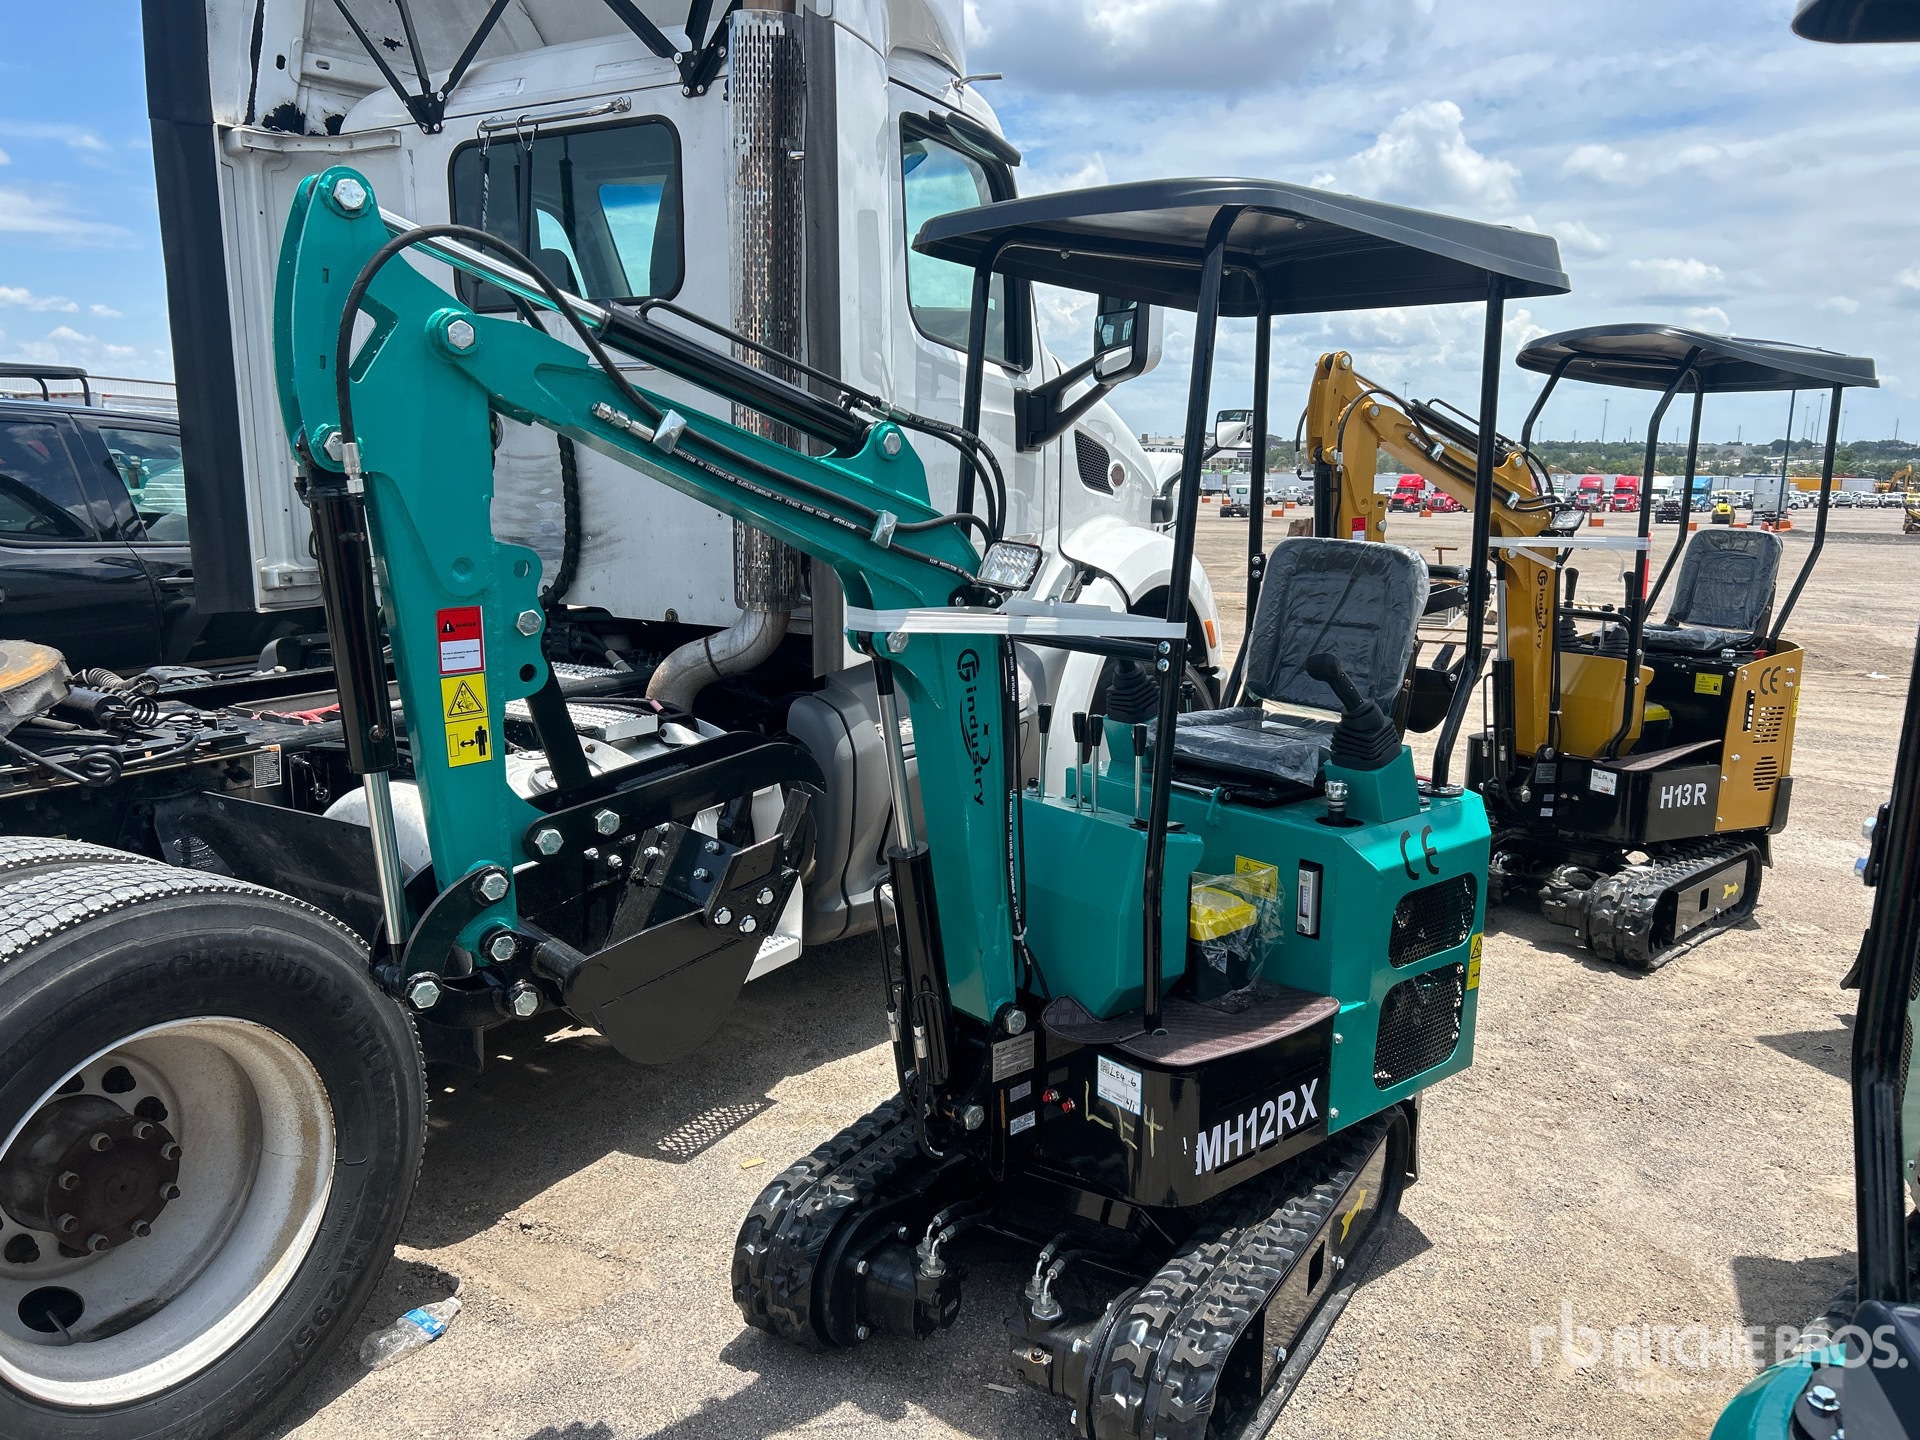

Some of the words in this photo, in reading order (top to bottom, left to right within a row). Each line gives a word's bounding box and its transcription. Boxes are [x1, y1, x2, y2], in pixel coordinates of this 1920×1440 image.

[1760, 666, 1781, 695] CE
[1660, 782, 1708, 810] H13R
[1399, 824, 1441, 880] CE
